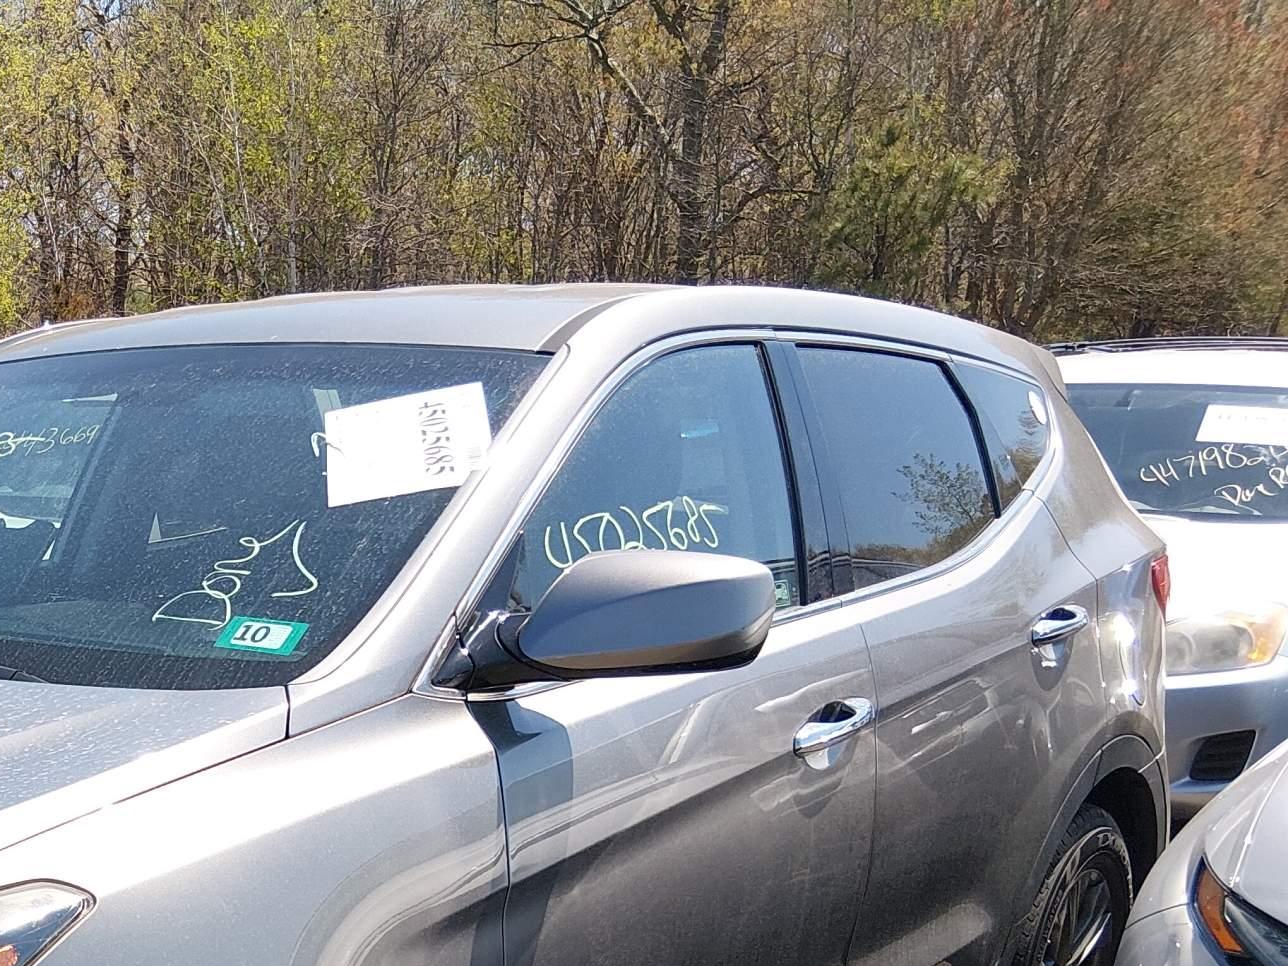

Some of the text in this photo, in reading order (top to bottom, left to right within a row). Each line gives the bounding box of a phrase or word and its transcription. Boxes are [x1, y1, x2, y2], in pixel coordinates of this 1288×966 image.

[418, 401, 455, 476] 45025685
[544, 495, 725, 569] 45025685
[232, 623, 271, 644] 10
